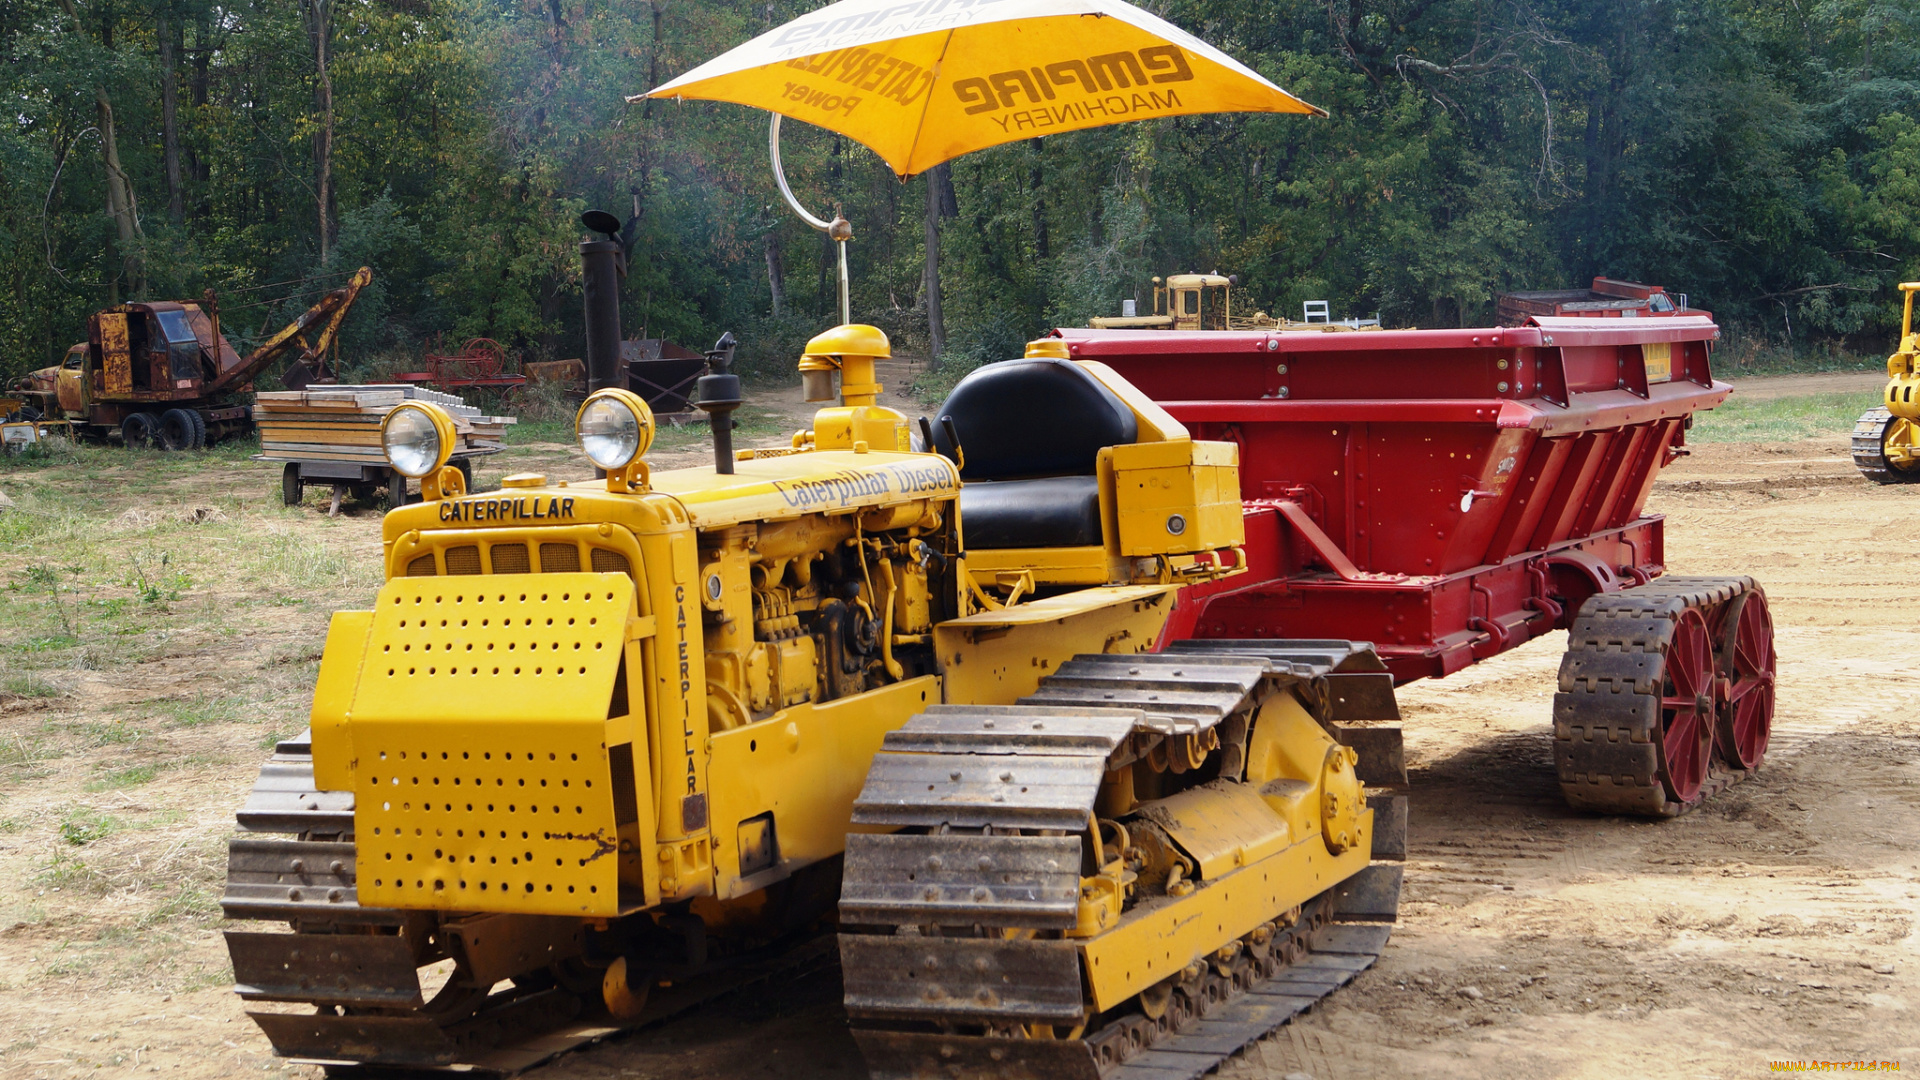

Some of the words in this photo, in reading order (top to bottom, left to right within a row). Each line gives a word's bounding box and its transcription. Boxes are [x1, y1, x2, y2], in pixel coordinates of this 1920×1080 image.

[778, 7, 987, 58] MACHINERY
[772, 470, 890, 507] Caterpillar
[888, 461, 954, 494] Diesel
[439, 497, 575, 522] CATERPILLAR
[674, 586, 697, 795] CATERPILLAR
